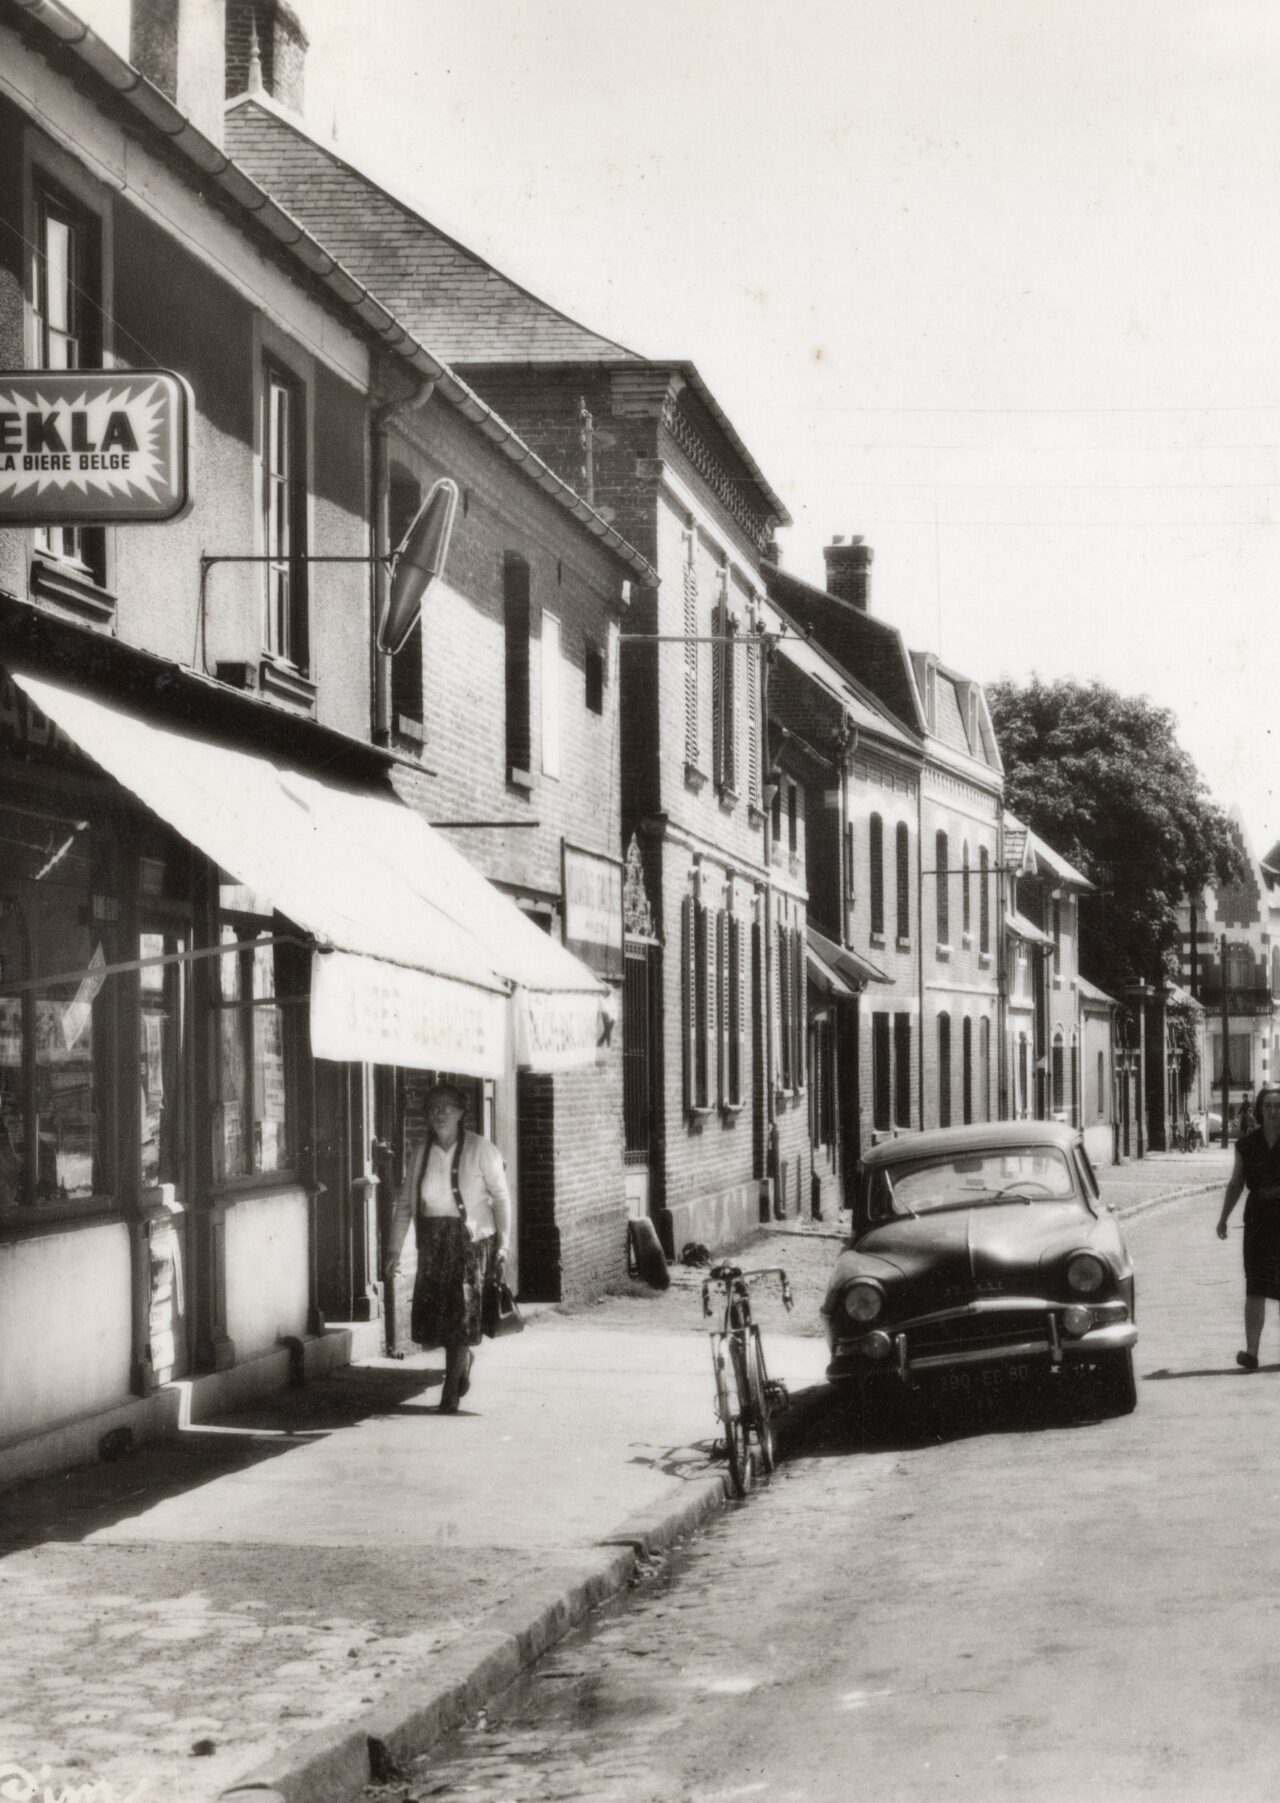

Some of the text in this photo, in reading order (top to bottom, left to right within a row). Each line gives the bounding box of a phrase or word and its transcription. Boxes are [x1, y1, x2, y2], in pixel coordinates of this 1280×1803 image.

[0, 411, 139, 453] EKLA
[23, 454, 71, 471] BIERE
[79, 454, 130, 470] BELGE
